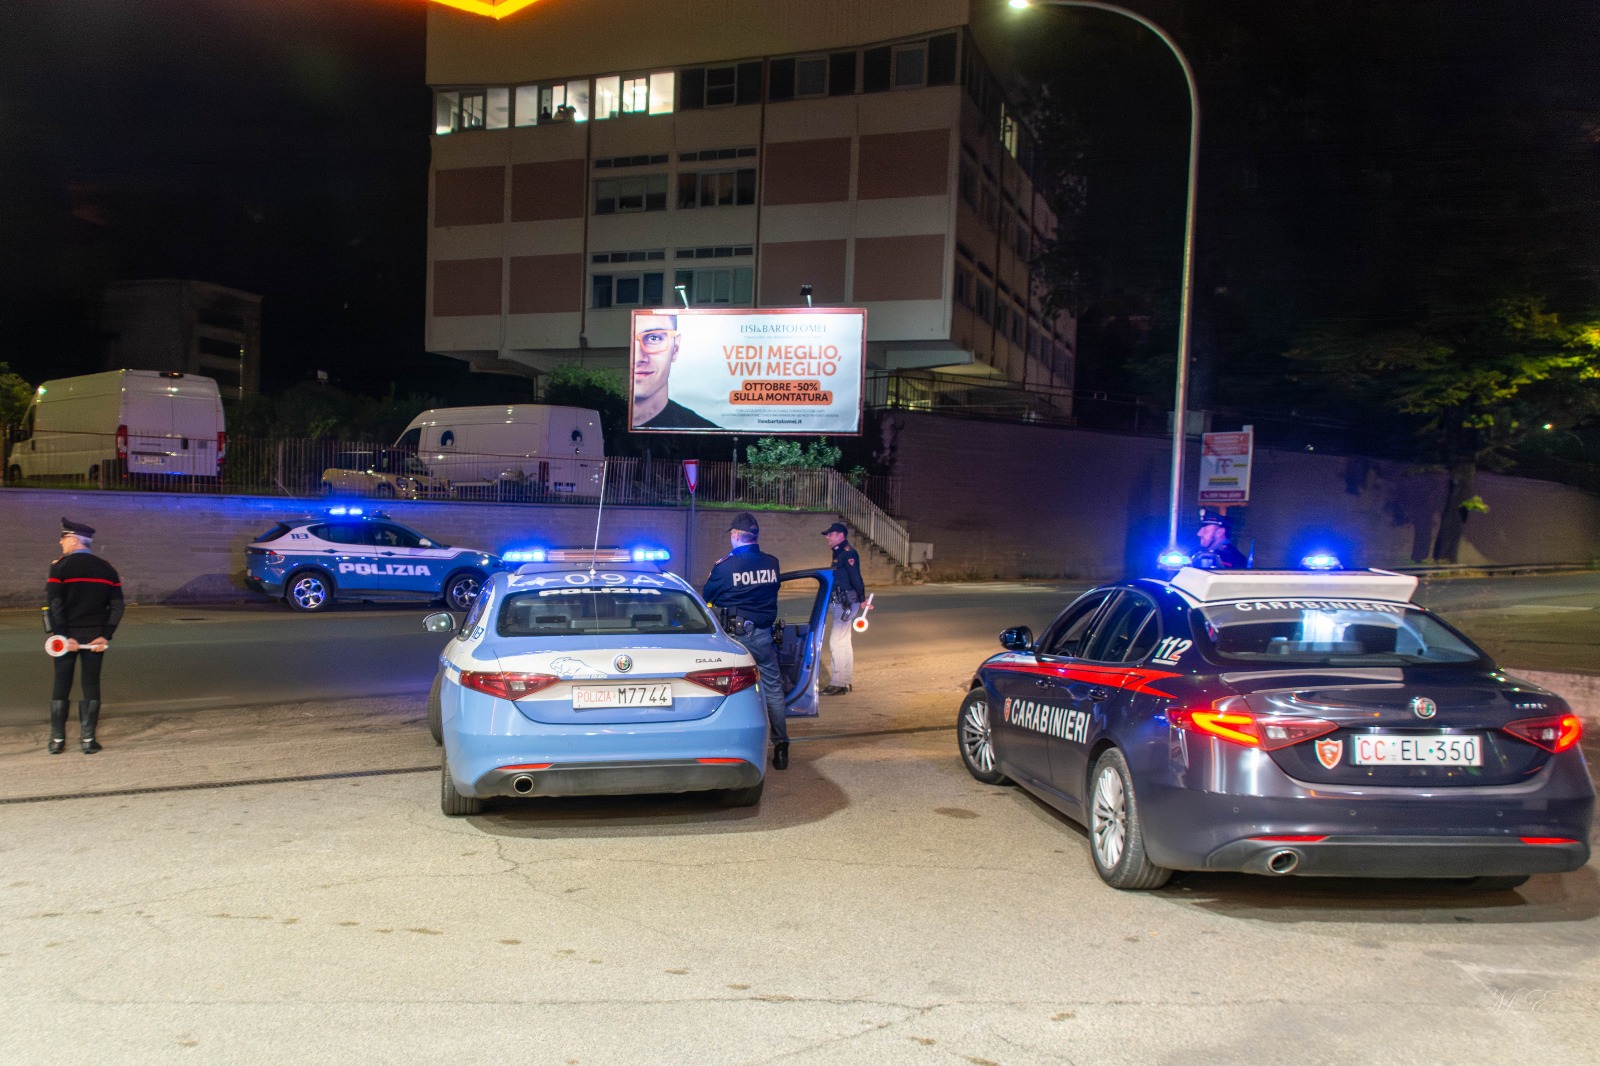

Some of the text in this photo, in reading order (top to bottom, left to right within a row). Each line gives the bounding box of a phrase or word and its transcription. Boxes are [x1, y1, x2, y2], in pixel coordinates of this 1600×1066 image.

[723, 345, 842, 362] VEDI MEGLIO,
[727, 361, 837, 376] VIVI MEGLIO
[744, 382, 818, 391] OTTOBRE -50%
[733, 392, 829, 402] SULLA MONTATURA
[338, 563, 431, 576] POLIZIA
[732, 569, 778, 586] POLIZIA
[538, 587, 662, 597] POLIZIA
[1234, 601, 1400, 613] CARABINIERI
[1154, 636, 1193, 661] 112
[577, 687, 667, 704] POLIZIA M7744
[1011, 698, 1091, 745] CARABINIERI
[1359, 740, 1386, 761] CC
